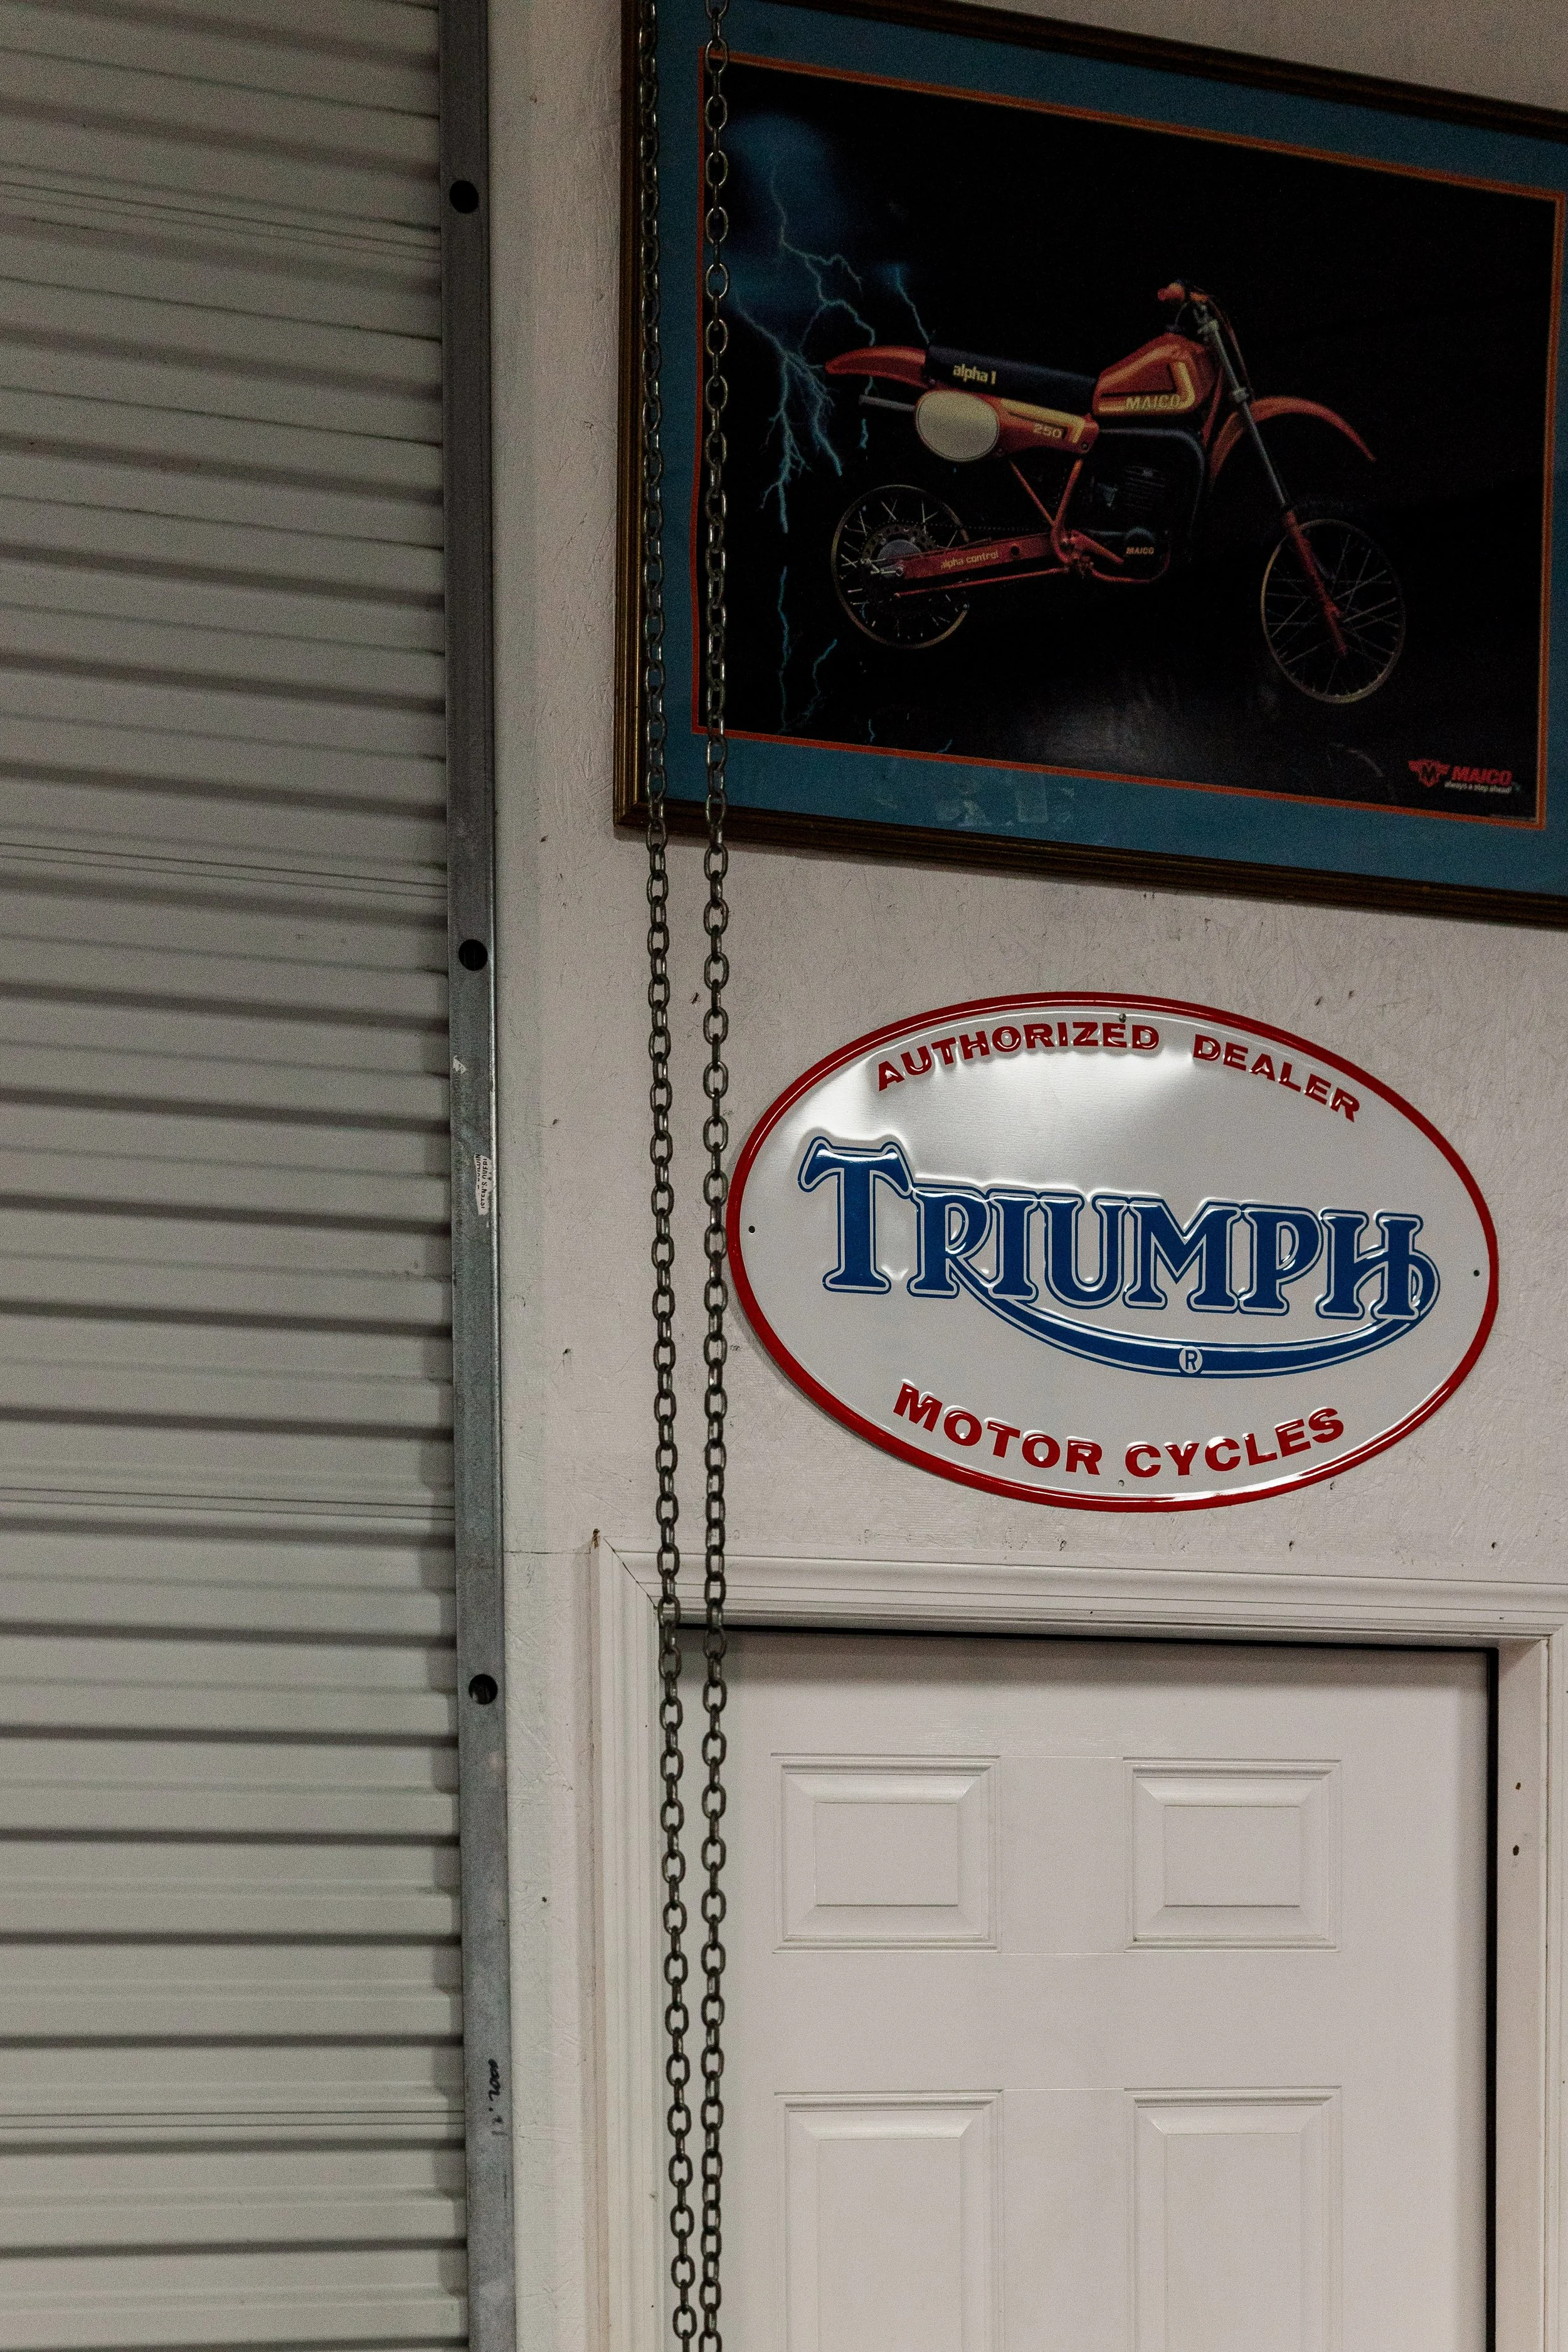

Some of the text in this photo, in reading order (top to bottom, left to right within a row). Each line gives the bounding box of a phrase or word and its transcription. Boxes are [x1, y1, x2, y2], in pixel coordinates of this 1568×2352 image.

[953, 364, 988, 384] alpha
[1126, 395, 1181, 410] MAICO
[1032, 423, 1062, 438] 250
[940, 551, 999, 569] alpha control
[1126, 546, 1155, 555] MAICO
[1451, 765, 1512, 785] MAICO
[877, 1021, 1360, 1122] AUTHORIZED DEALER
[798, 1136, 1440, 1378] TRIUMPH
[893, 1382, 1344, 1478] MOTOR CYCLES
